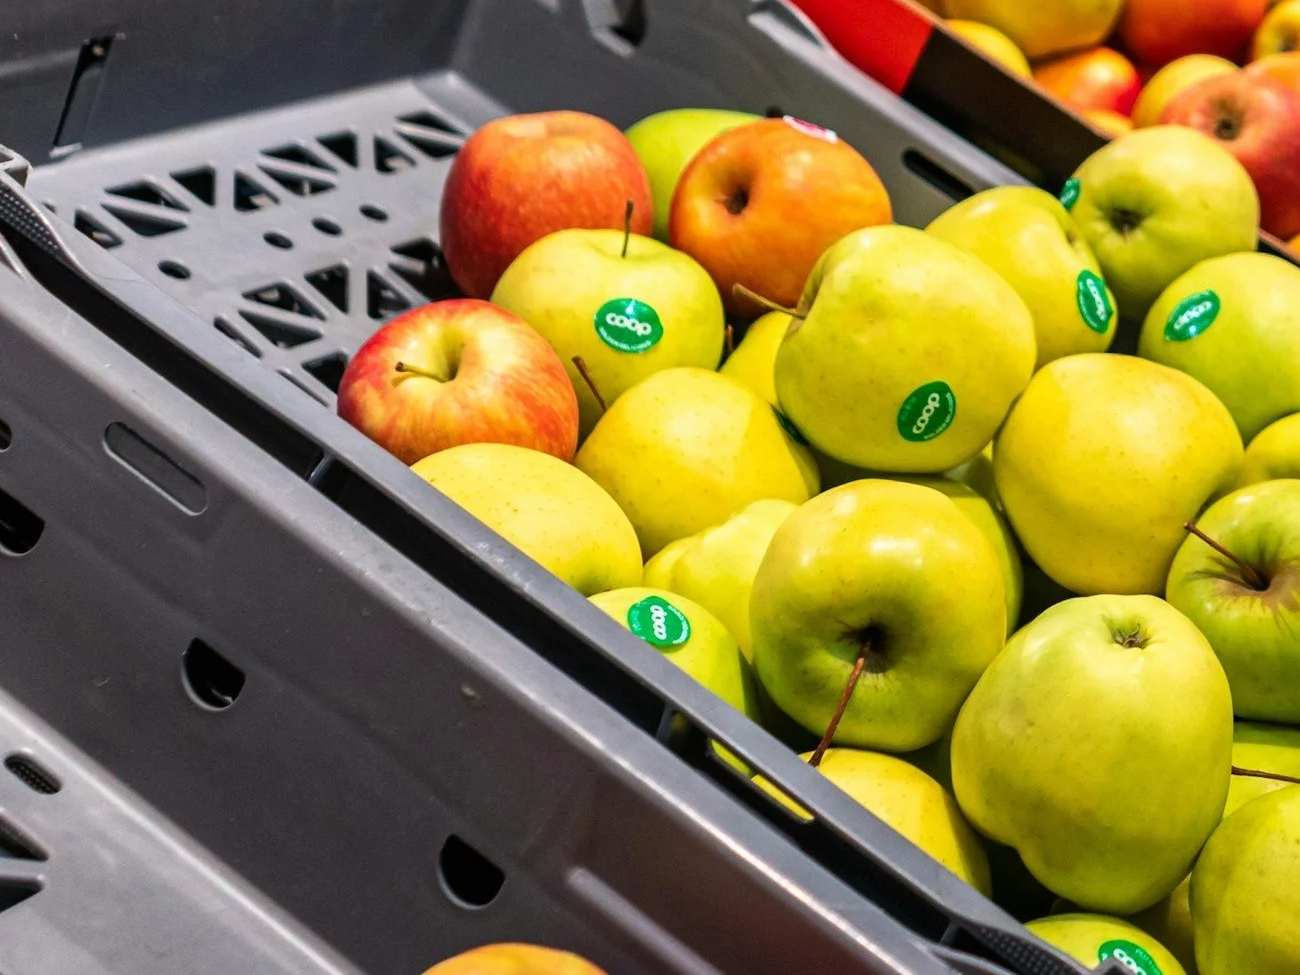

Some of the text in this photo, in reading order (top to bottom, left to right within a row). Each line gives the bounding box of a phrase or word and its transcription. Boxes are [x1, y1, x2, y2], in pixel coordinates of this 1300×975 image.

[605, 312, 652, 337] coop
[1174, 301, 1212, 329] coop
[912, 392, 940, 434] coop
[650, 605, 668, 640] coop
